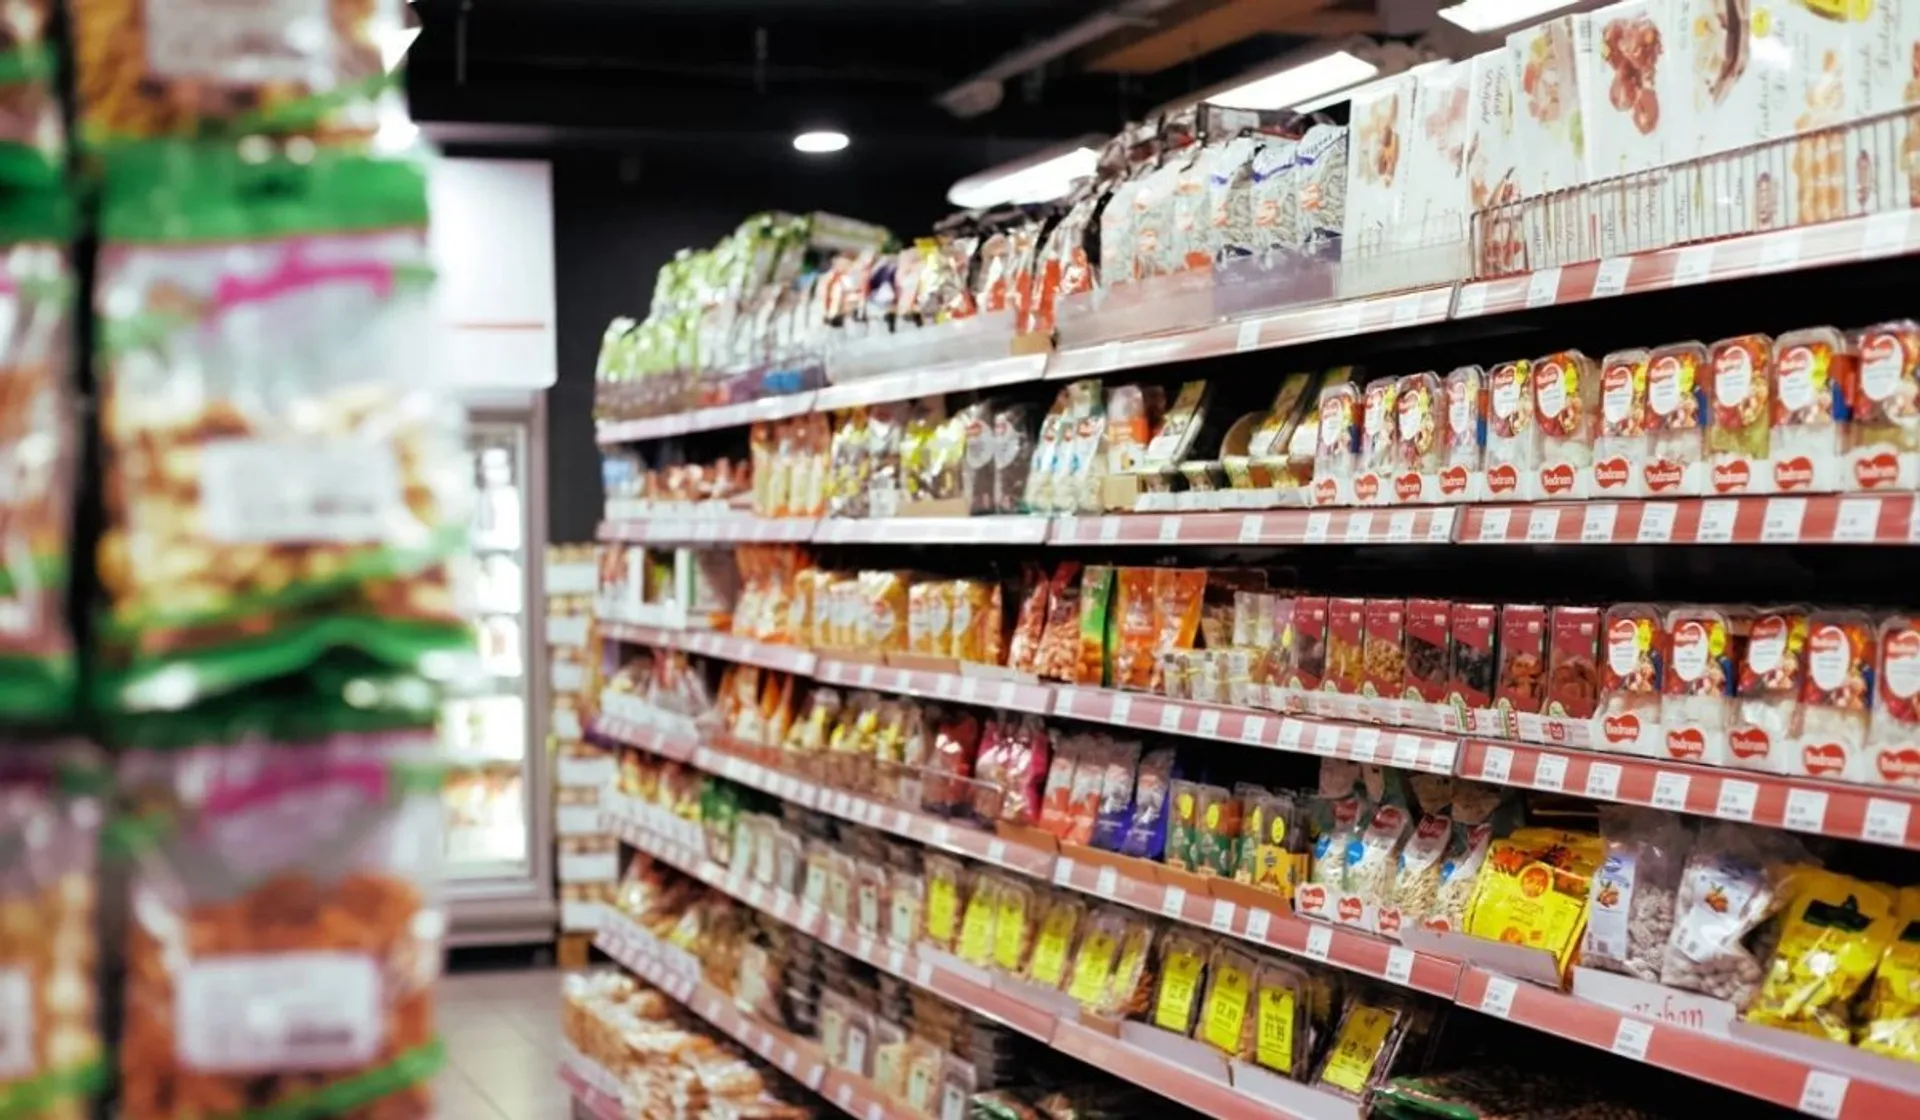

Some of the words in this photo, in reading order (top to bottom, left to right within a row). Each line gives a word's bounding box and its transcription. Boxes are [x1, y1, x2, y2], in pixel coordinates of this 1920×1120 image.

[1596, 467, 1627, 480] Bodrum
[1647, 469, 1682, 483] Bodrum
[1714, 468, 1748, 484] Bodrum
[1776, 465, 1812, 482] Bodrum
[1857, 461, 1897, 479] Bodrum
[1543, 472, 1572, 485] Bodrum
[1605, 720, 1638, 736] Bodrum
[1668, 735, 1702, 752] Bodrum
[1731, 735, 1768, 752] Bodrum
[1804, 748, 1843, 767] Bodrum
